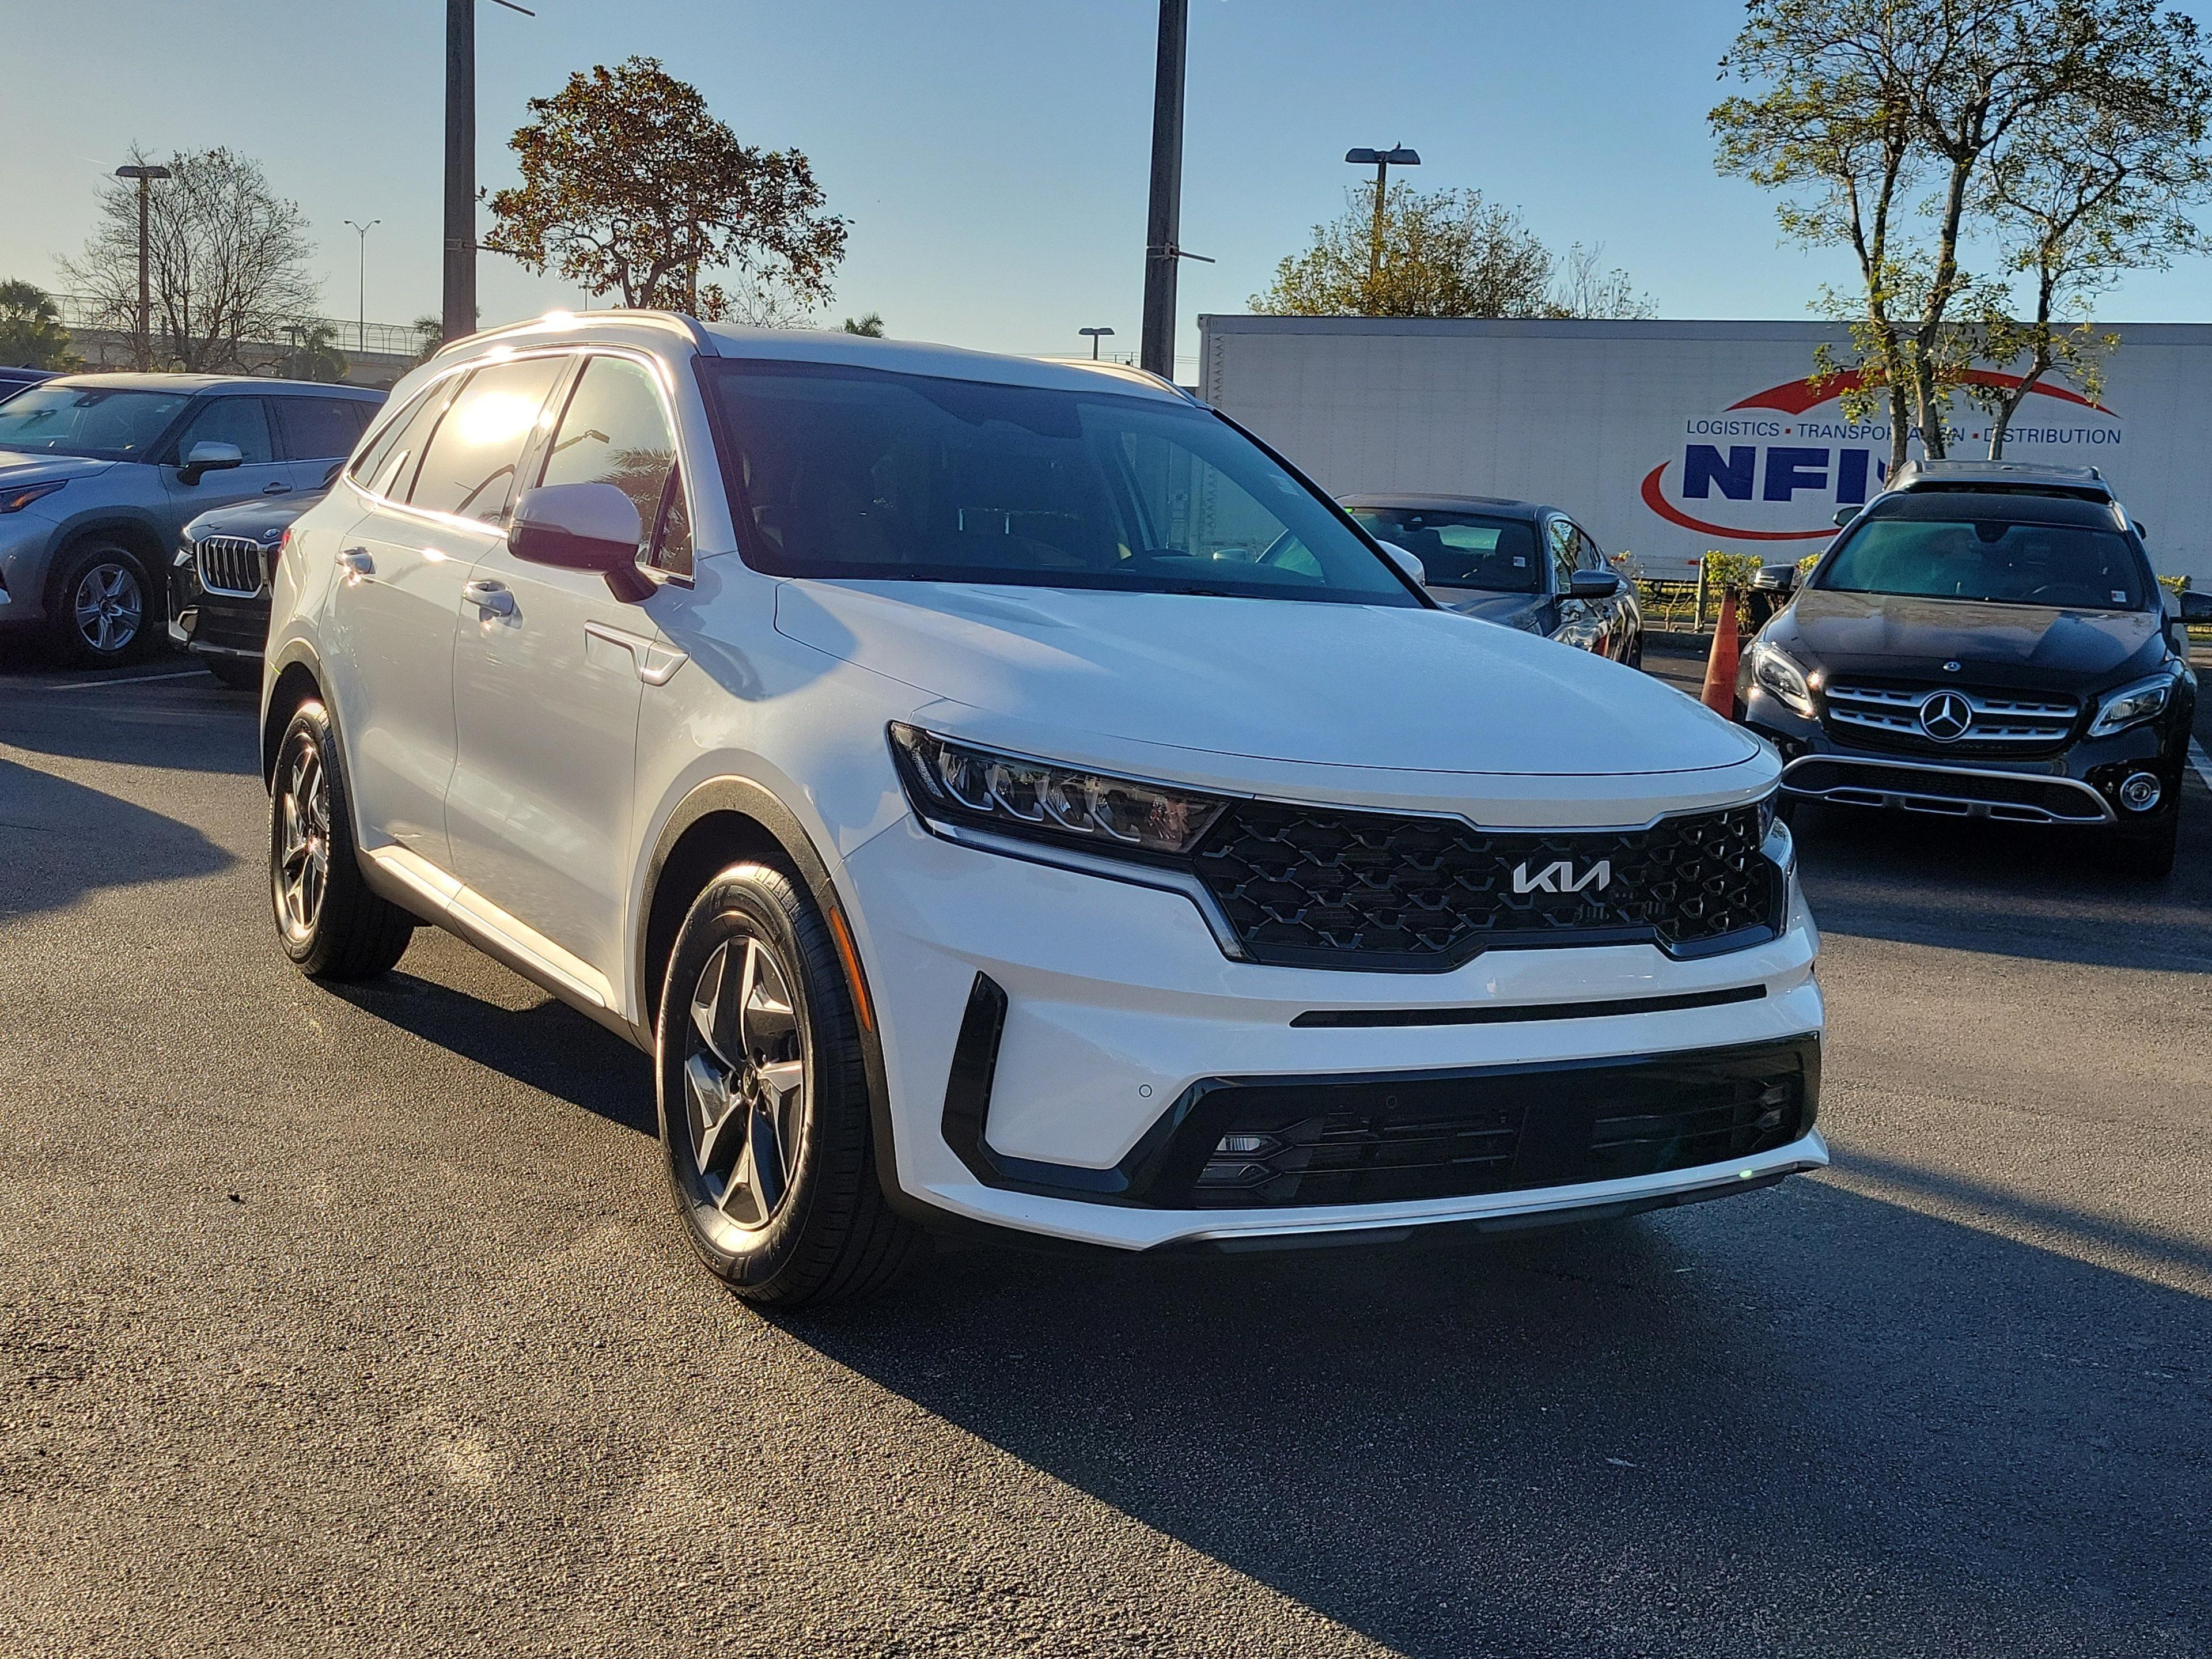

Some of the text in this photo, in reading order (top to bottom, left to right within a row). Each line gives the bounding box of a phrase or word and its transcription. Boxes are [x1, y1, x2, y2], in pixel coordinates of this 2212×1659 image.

[1687, 420, 1779, 436] LOGISTICS
[1984, 428, 2121, 444] DSTRIBUTION
[1683, 444, 1869, 504] NFI
[1513, 861, 1610, 893] KIA
